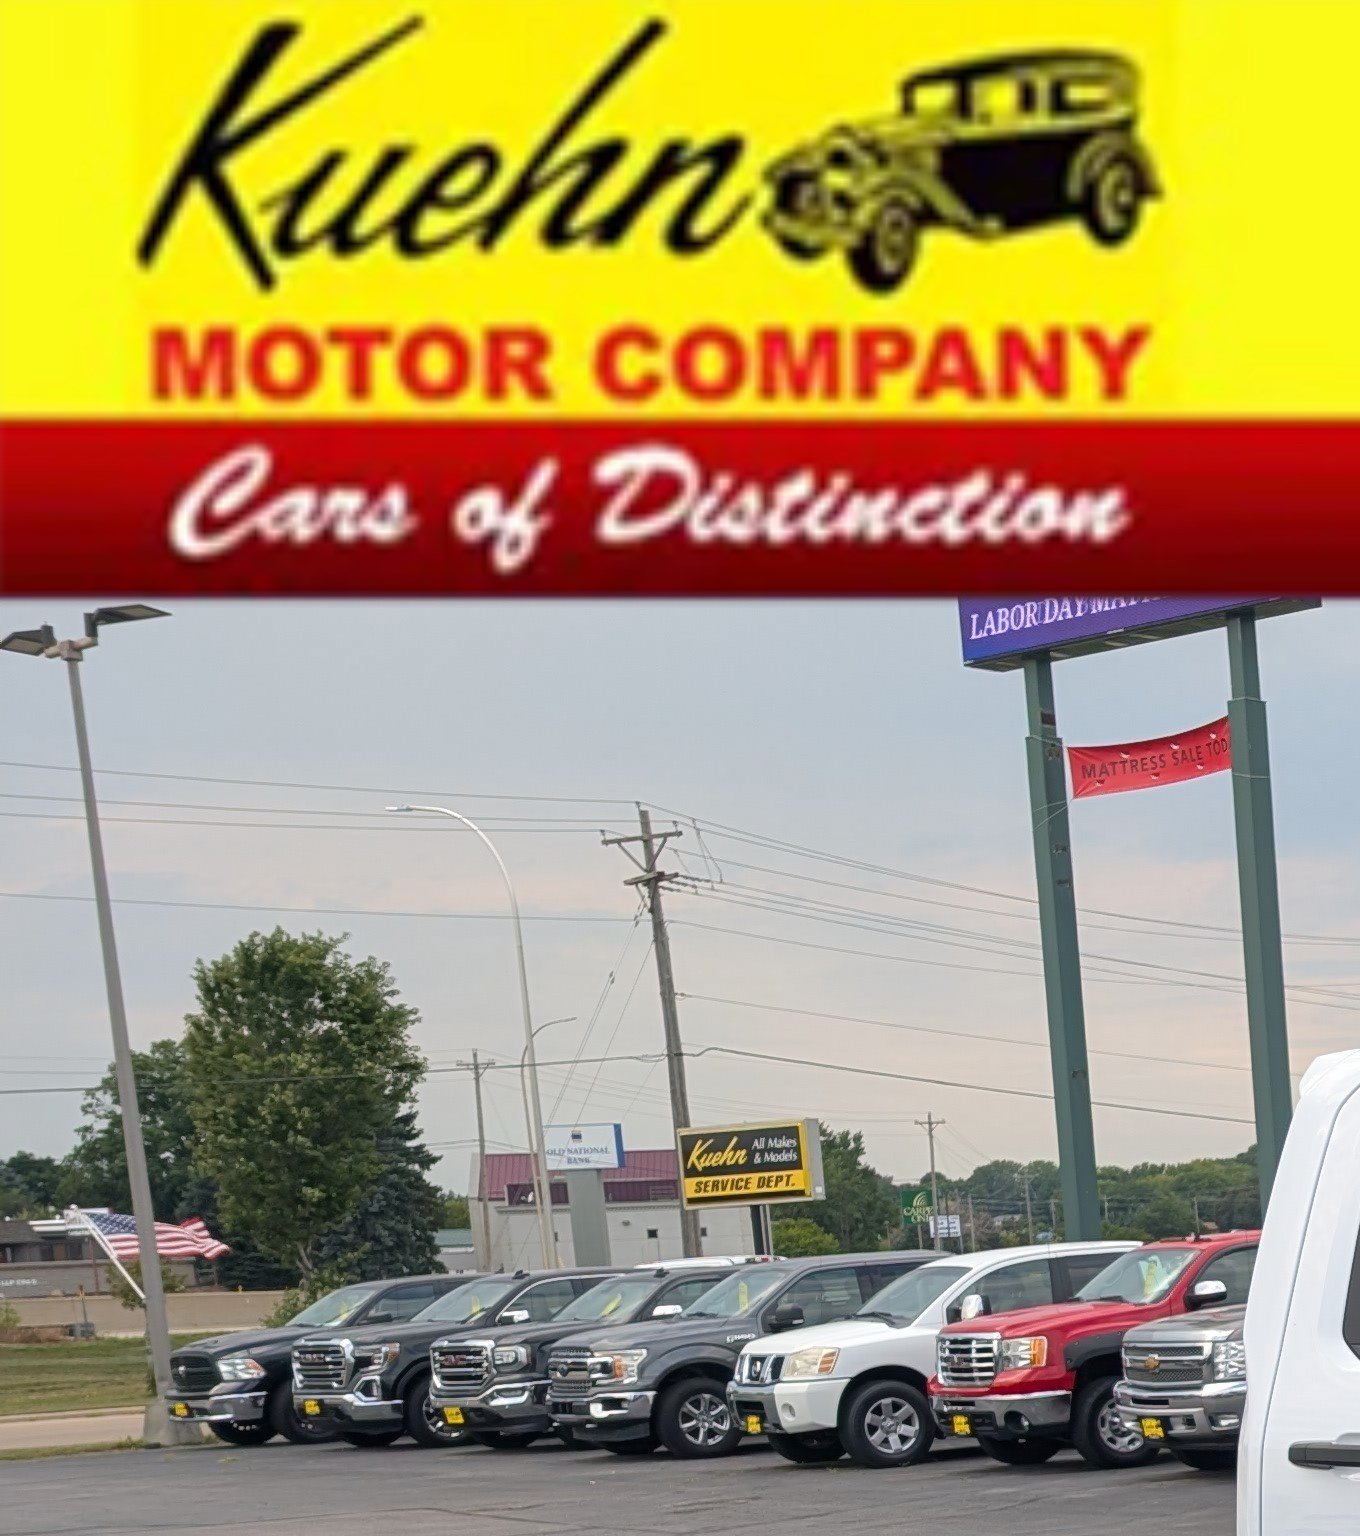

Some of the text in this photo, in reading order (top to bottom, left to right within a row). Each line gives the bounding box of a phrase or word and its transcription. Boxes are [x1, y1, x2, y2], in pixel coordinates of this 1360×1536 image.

[970, 606, 1039, 639] LABOR
[1042, 597, 1085, 625] DAY
[1082, 737, 1231, 779] MATTRESS SALE TOD
[567, 1145, 610, 1156] NATIONAL
[752, 1135, 797, 1150] All Makes
[687, 1136, 747, 1171] Kuehn
[753, 1149, 797, 1164] & Models
[694, 1174, 795, 1194] SERVICE DEPT.
